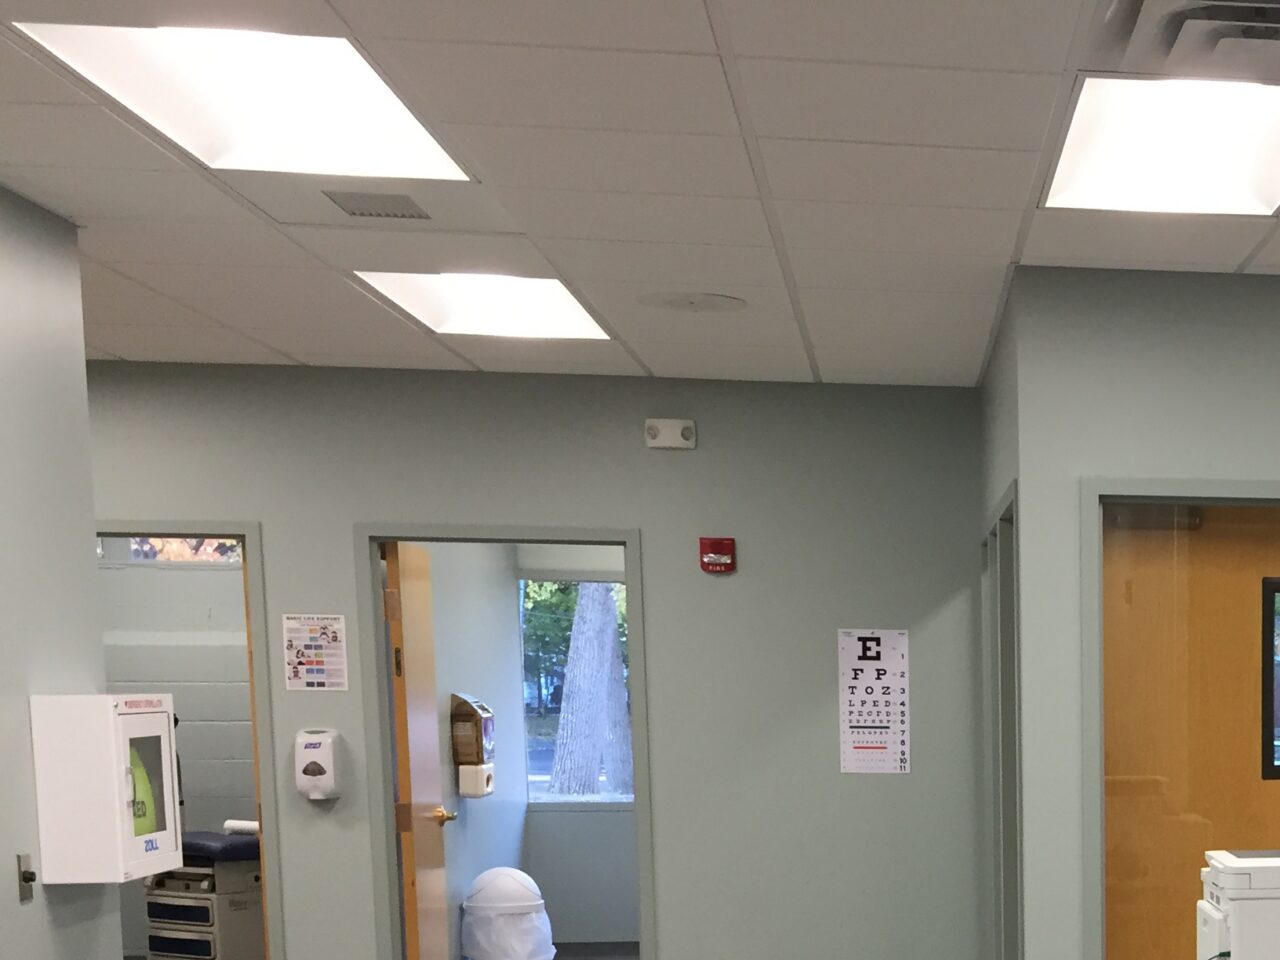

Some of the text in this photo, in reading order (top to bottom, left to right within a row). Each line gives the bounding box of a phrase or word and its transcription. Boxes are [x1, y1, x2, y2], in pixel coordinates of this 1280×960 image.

[857, 636, 881, 661] E
[851, 668, 864, 680] F
[875, 668, 887, 680] P
[848, 686, 857, 695] T
[865, 686, 874, 695] O
[881, 686, 891, 695] Z
[144, 838, 159, 852] ZOLL
